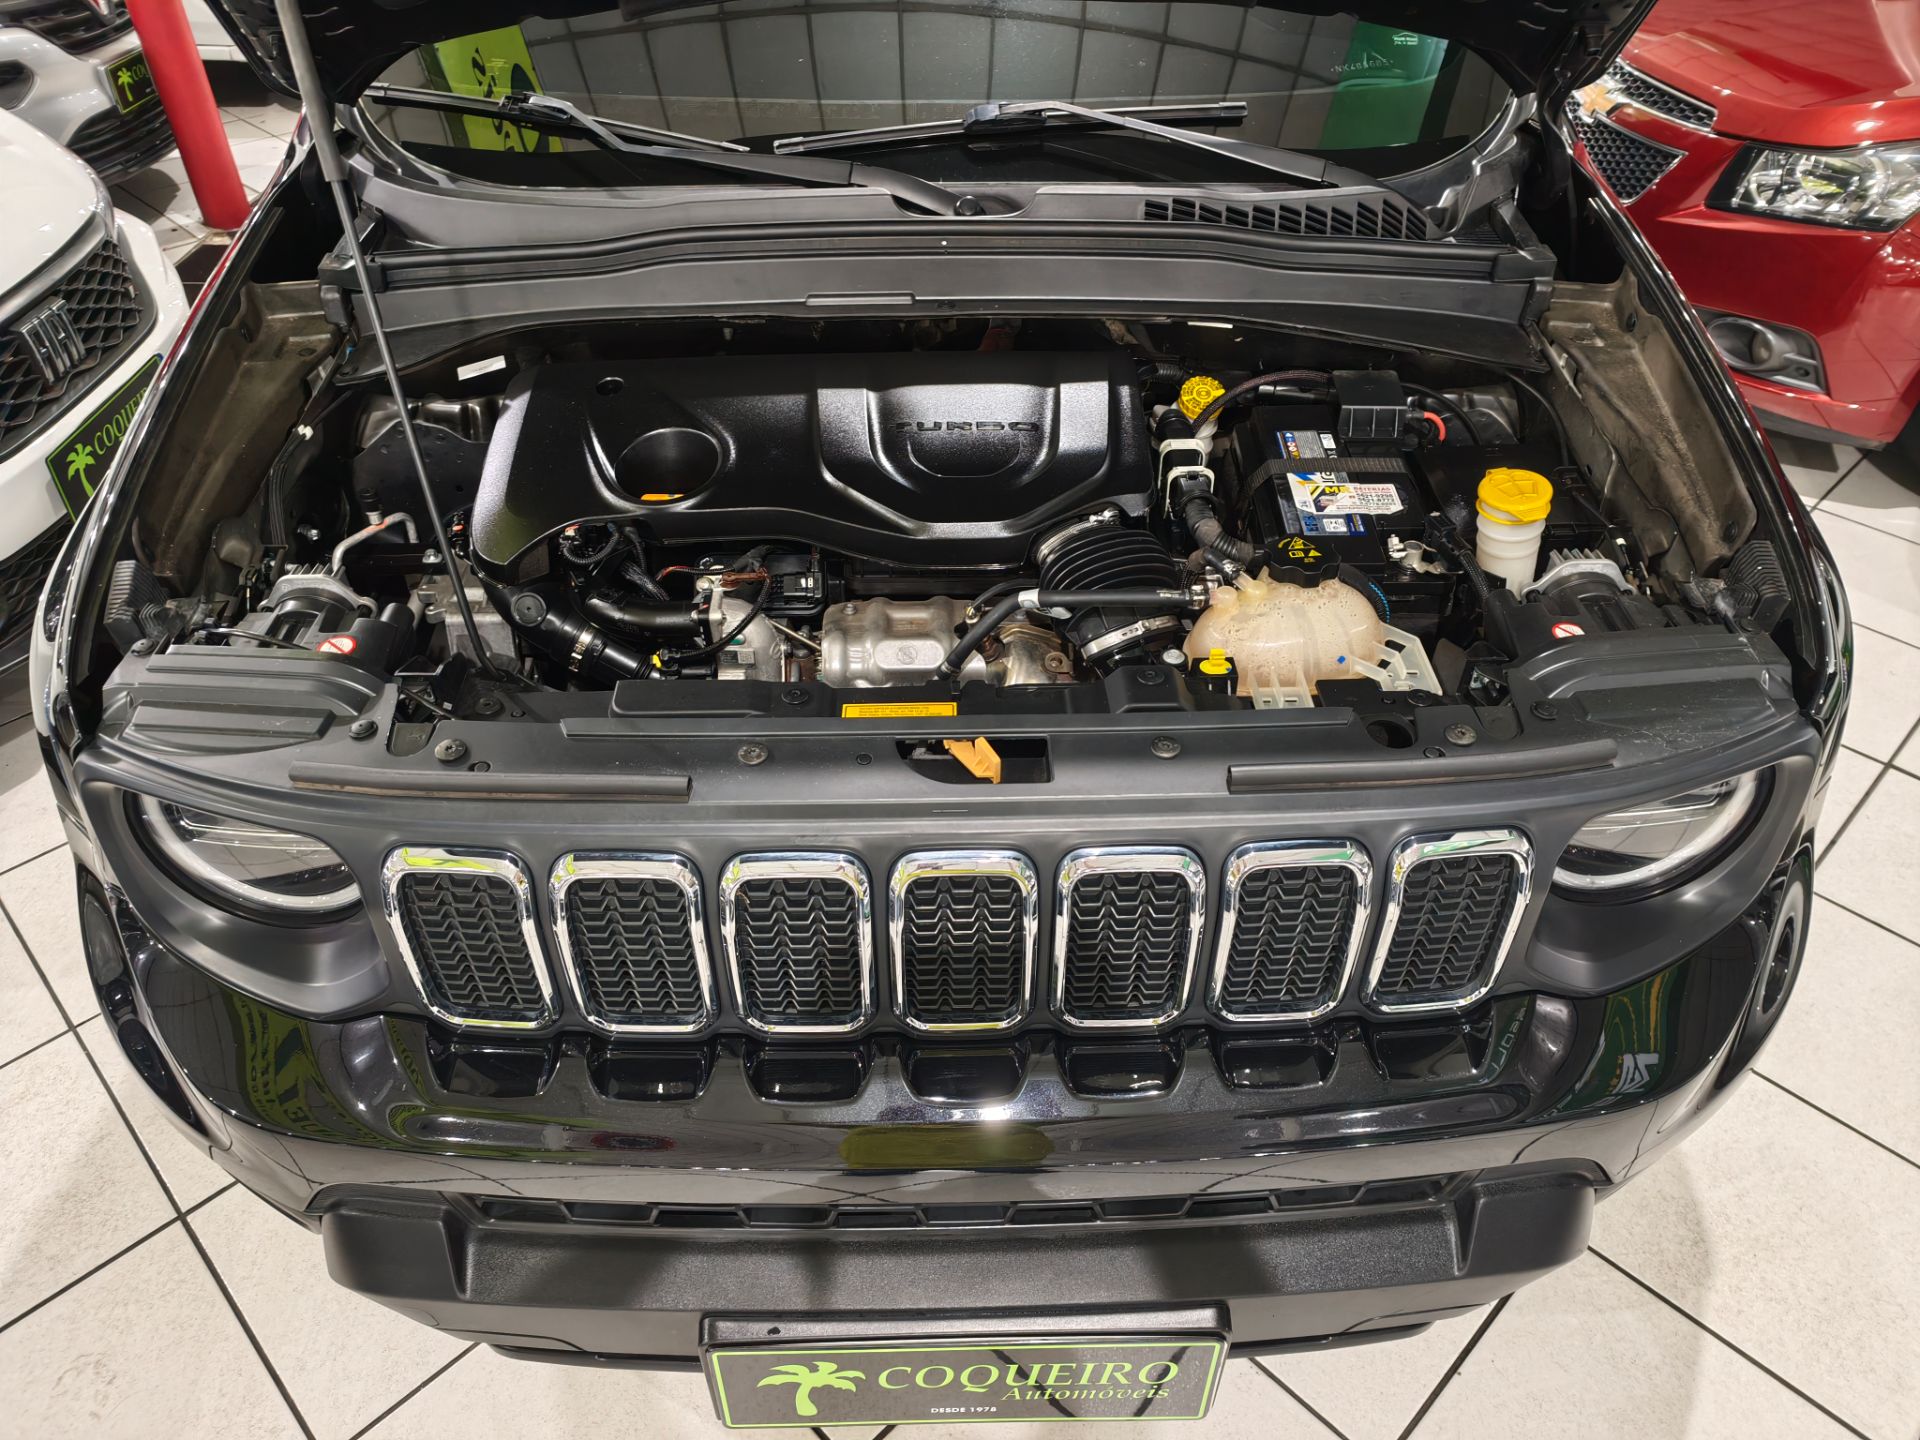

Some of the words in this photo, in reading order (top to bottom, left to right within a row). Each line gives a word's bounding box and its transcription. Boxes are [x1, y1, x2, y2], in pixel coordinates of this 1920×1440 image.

[20, 299, 87, 385] FIAT
[891, 421, 1040, 432] TURBO
[878, 1360, 1179, 1392] COQUEIRO
[1001, 1384, 1169, 1400] Automóveis
